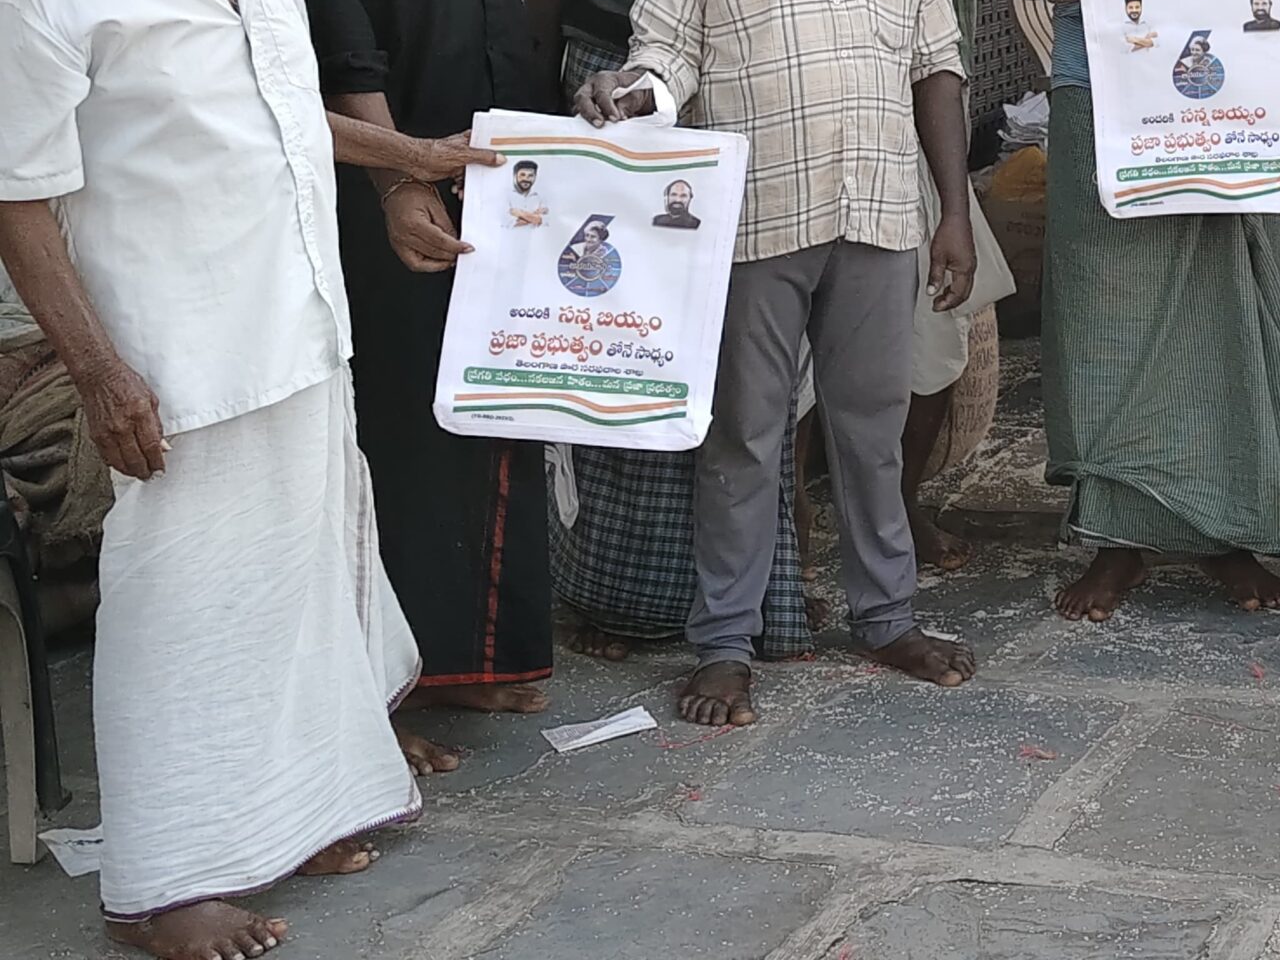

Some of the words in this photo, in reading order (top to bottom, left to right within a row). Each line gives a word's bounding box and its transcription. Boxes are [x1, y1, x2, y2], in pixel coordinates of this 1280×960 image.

[1181, 108, 1210, 126] సన్న
[1212, 106, 1266, 125] బియ్యం
[1131, 135, 1160, 155] ప్రజా
[1164, 131, 1221, 154] ప్రభుత్వం
[1248, 131, 1280, 146] సాధ్యం
[559, 306, 594, 331] సన్న
[597, 312, 662, 337] బియ్యం
[489, 330, 527, 355] ప్రజా
[530, 333, 603, 362] ప్రభుత్వం
[635, 346, 673, 367] సాధ్యం
